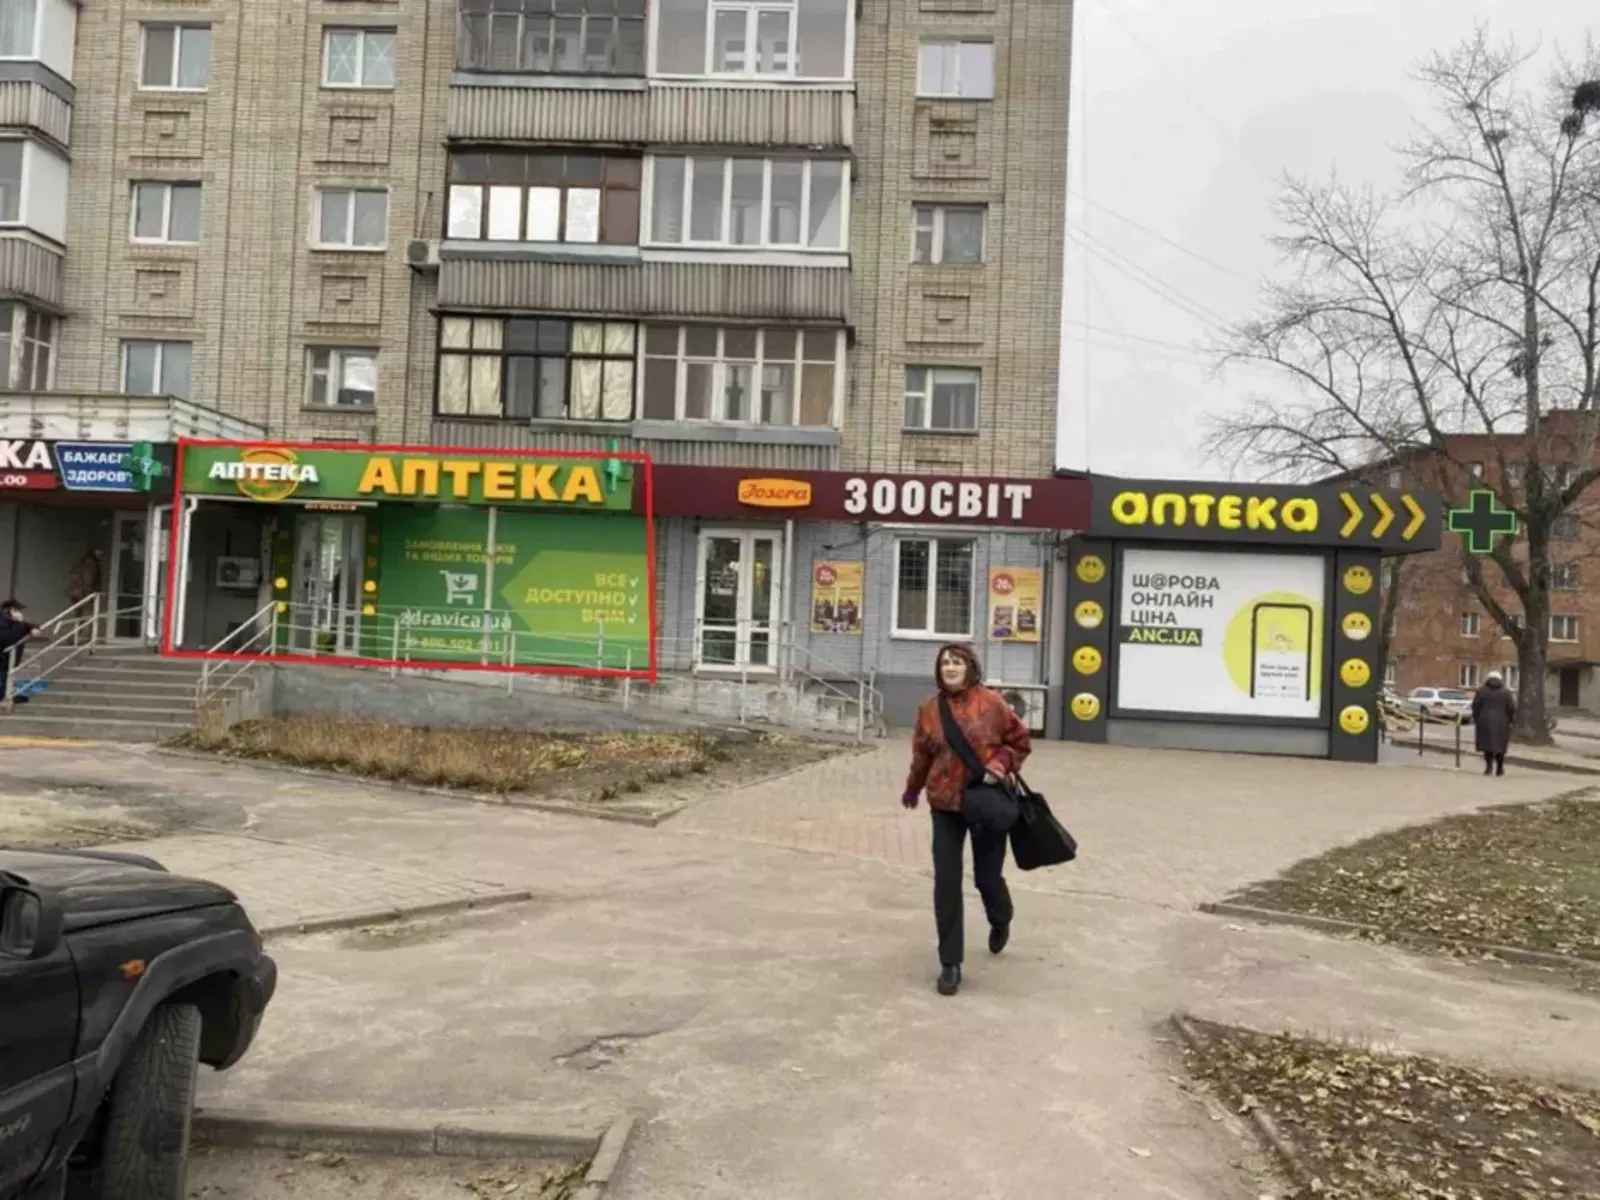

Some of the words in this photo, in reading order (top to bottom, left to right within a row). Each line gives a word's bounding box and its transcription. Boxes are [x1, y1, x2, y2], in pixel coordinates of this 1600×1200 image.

[67, 469, 132, 484] ЗДОРОВ'
[209, 461, 319, 483] АПТЕКА
[358, 457, 606, 504] АПТЕКА
[742, 483, 808, 500] Josera
[844, 478, 1033, 519] ЗООСВІТ
[595, 573, 626, 588] ВСЕ
[1132, 573, 1220, 590] Ш@РОВА
[525, 588, 626, 606] ДОСТУПНО
[1131, 591, 1214, 608] ОНЛАЙН
[400, 610, 513, 631] zdravicaua
[1130, 610, 1178, 626] ЦІНА
[1128, 627, 1200, 645] ANC.UA
